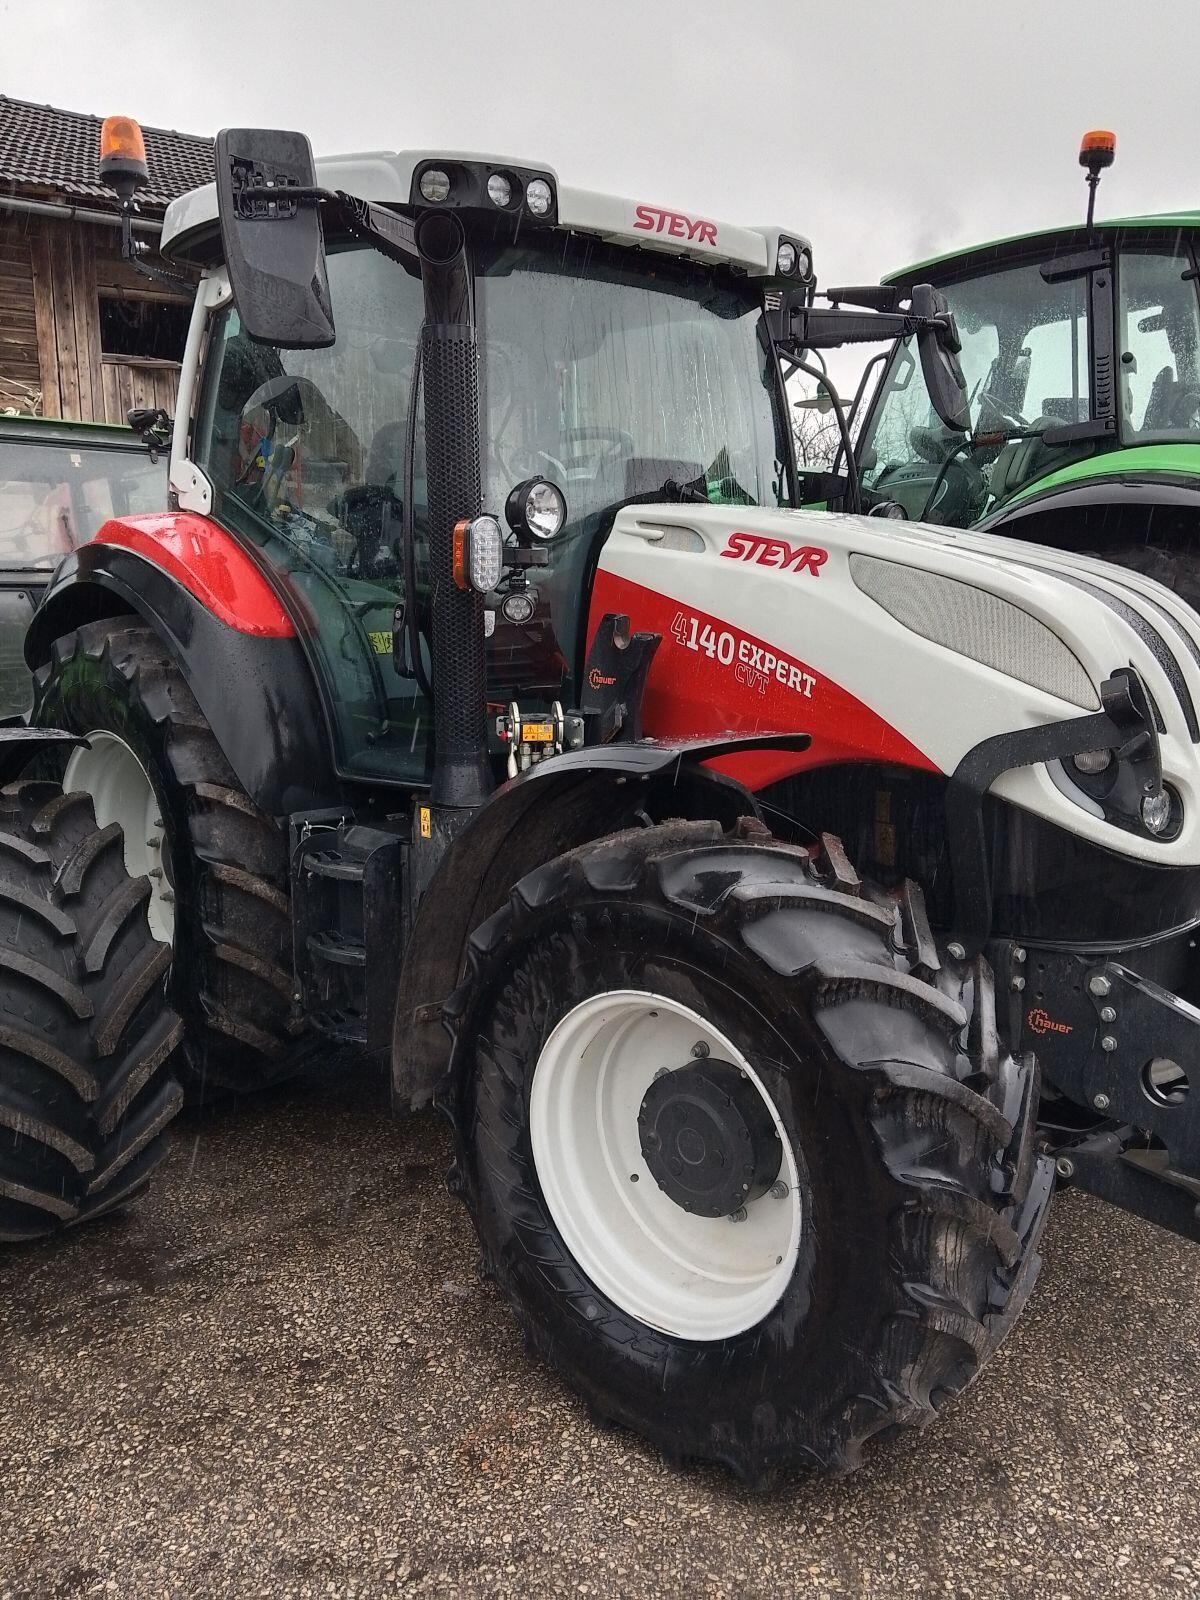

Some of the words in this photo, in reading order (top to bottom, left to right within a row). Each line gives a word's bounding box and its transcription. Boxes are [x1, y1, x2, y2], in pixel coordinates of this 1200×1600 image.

[633, 205, 718, 247] STEYR
[719, 532, 829, 578] STEYR
[670, 611, 735, 666] 4140
[738, 639, 817, 699] EXPERT
[593, 672, 617, 685] hauer
[734, 662, 770, 695] CVT
[1034, 1014, 1074, 1034] hauer
